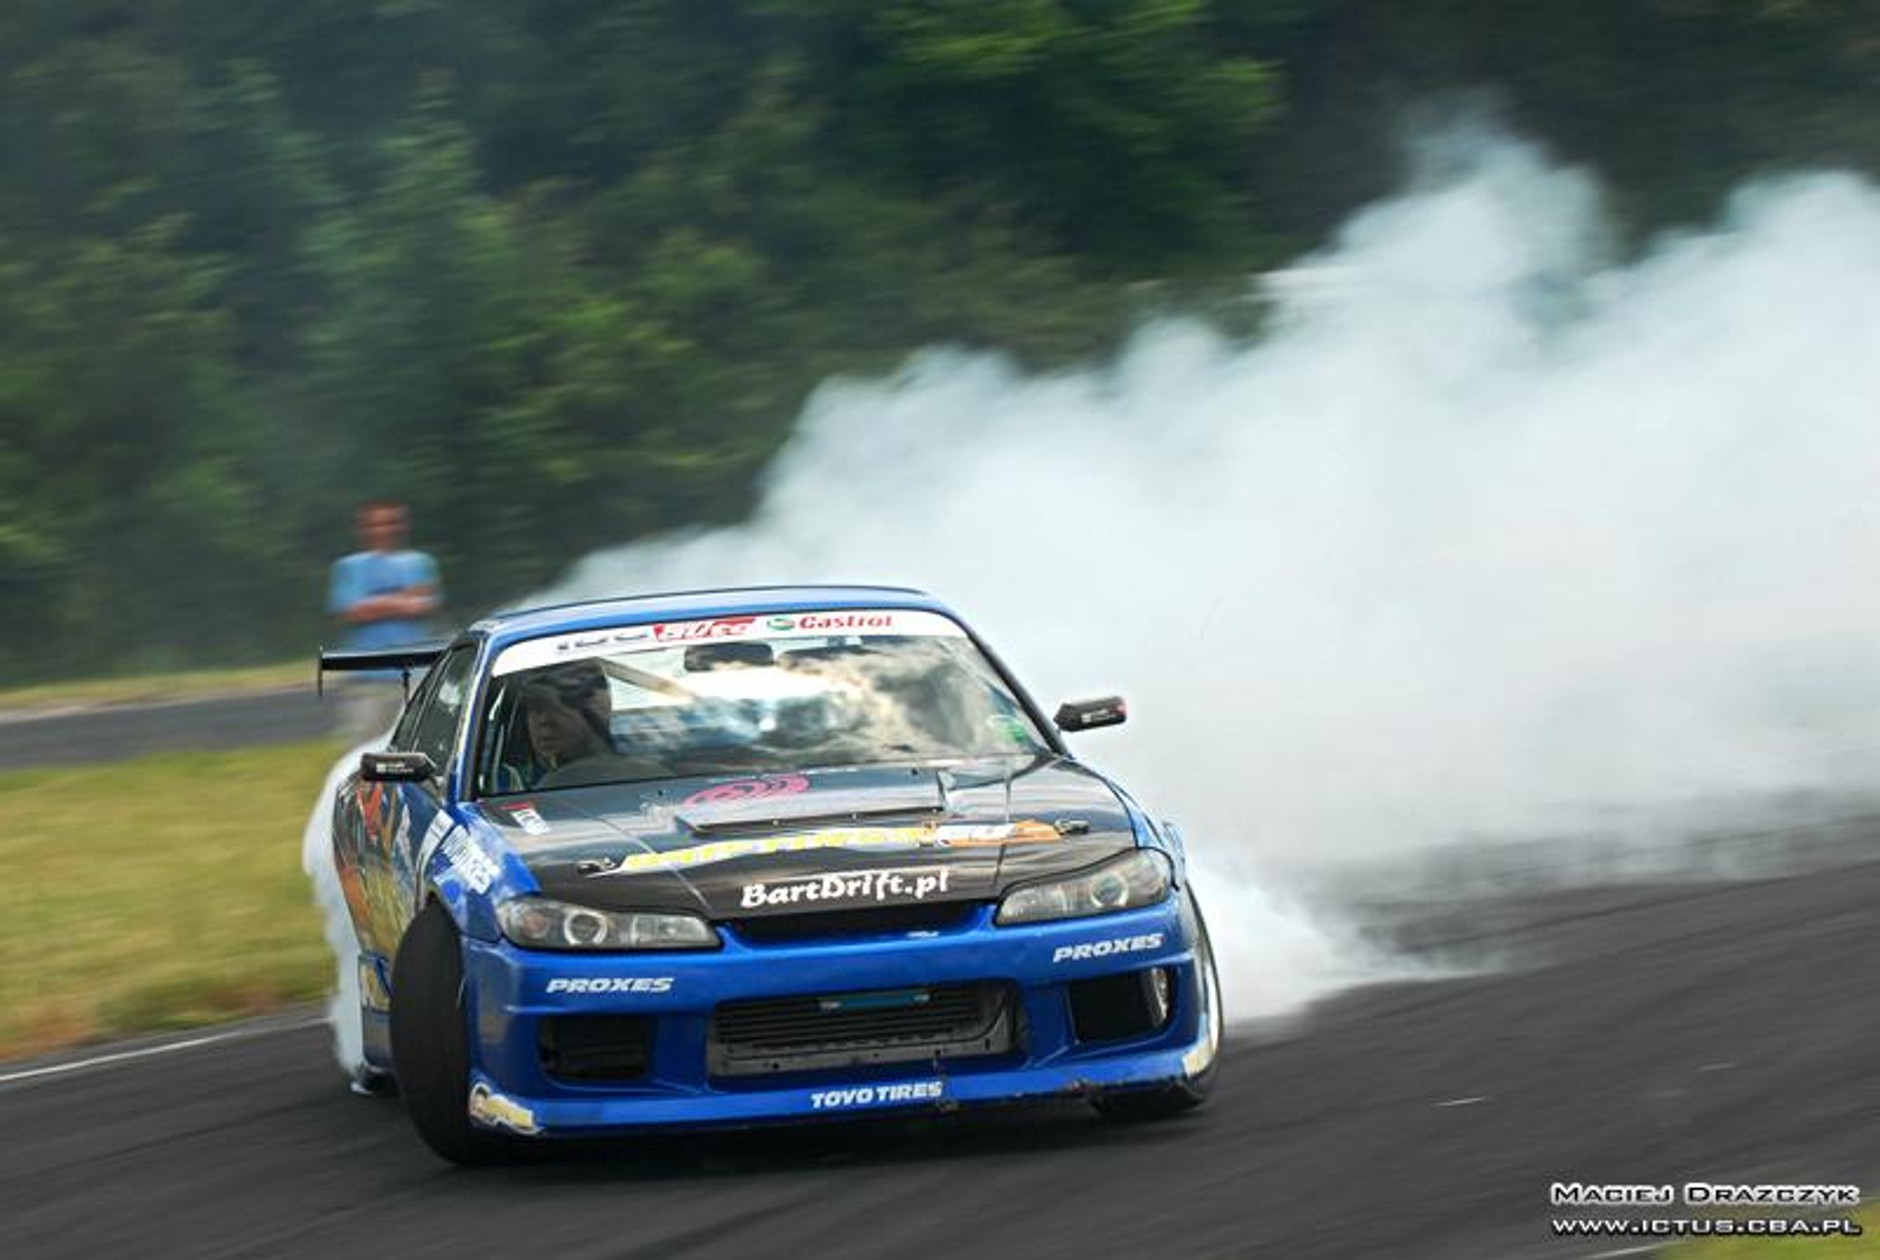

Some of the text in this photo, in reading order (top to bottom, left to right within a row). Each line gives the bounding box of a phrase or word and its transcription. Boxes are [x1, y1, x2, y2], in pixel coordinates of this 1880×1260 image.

[799, 614, 893, 629] Castrol
[740, 870, 949, 909] BartDrift.pl
[1052, 933, 1164, 963] PROXES
[545, 977, 674, 993] PROXES
[810, 1081, 943, 1109] TOYO TIRES
